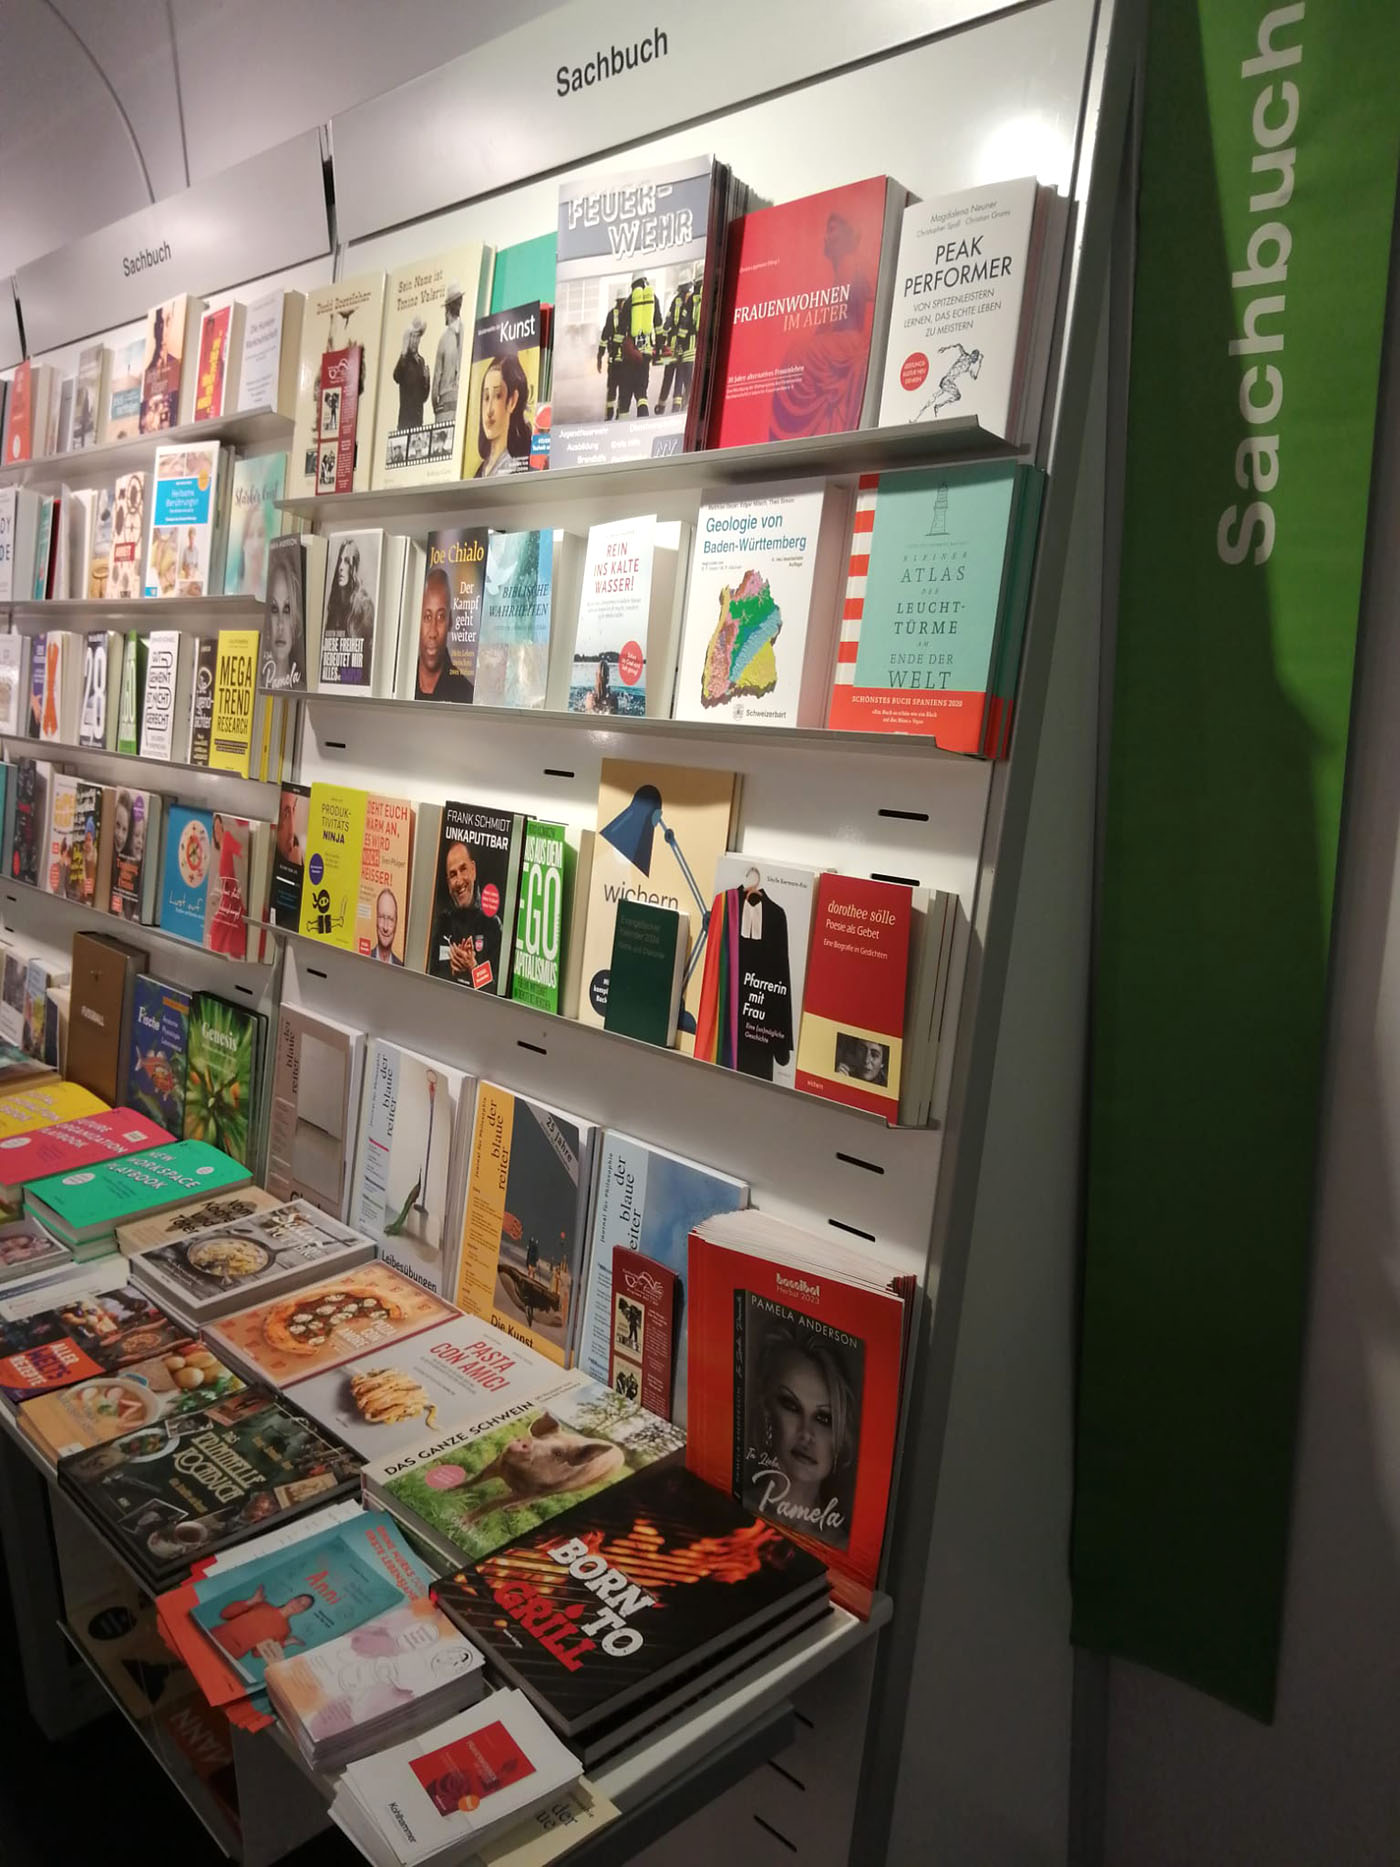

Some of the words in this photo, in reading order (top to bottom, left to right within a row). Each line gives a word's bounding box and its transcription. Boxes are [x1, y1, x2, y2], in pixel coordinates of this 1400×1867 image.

[557, 27, 668, 97] Sachbuch
[568, 184, 672, 231] FEUER-
[608, 208, 693, 260] WEHR
[123, 241, 171, 277] Sachbuch
[935, 235, 984, 265] PEAK
[904, 256, 1012, 297] PERFORMER
[1217, 2, 1305, 566] Sachbuch
[733, 284, 851, 325] FRAUENWOHNEN
[914, 298, 931, 312] VON
[932, 288, 995, 310] SPITZENLEISTERN
[500, 314, 536, 343] Kunst
[783, 313, 801, 332] IM
[803, 303, 848, 328] ALTER
[903, 315, 933, 329] LERNEN,
[935, 311, 951, 323] DAS
[953, 305, 976, 320] ECHTE
[978, 301, 1002, 315] LEBEN
[925, 326, 936, 337] ZU
[937, 320, 973, 336] MEISTERN
[706, 514, 757, 535] Geologie
[762, 513, 783, 529] von
[430, 547, 445, 568] Joe
[448, 540, 484, 563] Chialo
[607, 541, 628, 558] REIN
[703, 535, 807, 554] Baden-Württemberg
[593, 563, 608, 577] INS
[611, 557, 640, 575] KALTE
[901, 566, 966, 583] ATLAS
[460, 581, 474, 595] Der
[502, 583, 550, 600] BIBLISCHE
[595, 575, 635, 594] WASSER!
[453, 595, 480, 613] Kampf
[489, 603, 549, 618] WAHRHEITEN
[897, 601, 966, 614] LEUCHT-
[455, 612, 473, 630] geht
[894, 619, 958, 635] TÜRME
[451, 630, 476, 643] weiter
[219, 655, 252, 688] MEGA
[890, 653, 923, 665] ENDE
[928, 655, 954, 665] DER
[262, 660, 302, 690] Pamela
[888, 671, 952, 690] WELT
[218, 688, 250, 716] TREND
[745, 709, 787, 719] Schweizerbart
[852, 695, 891, 705] SCHÖNSTES
[892, 697, 911, 706] BUCH
[912, 698, 947, 707] SPANIENS
[217, 716, 248, 735] RESEARCH
[321, 803, 352, 819] PRODUK-
[384, 803, 408, 821] EUCH
[446, 809, 473, 825] FRANK
[475, 814, 511, 832] SCHMIDT
[322, 830, 345, 845] NINJA
[372, 835, 390, 851] WIRD
[385, 820, 400, 839] AN,
[445, 826, 509, 850] UNKAPUTTBAR
[546, 839, 563, 868] DEM
[827, 900, 868, 920] dorothee
[869, 909, 896, 926] sölle
[825, 919, 846, 932] Poesie
[846, 923, 856, 934] als
[856, 926, 880, 940] Gebet
[823, 938, 834, 947] Eine
[860, 946, 889, 960] Gedichten
[744, 972, 787, 995] Pfarrerin
[742, 1003, 766, 1021] Frau
[748, 991, 765, 1005] mit
[137, 1006, 160, 1031] Fische
[201, 1021, 237, 1052] Genesis
[744, 1031, 769, 1044] Geschichte
[381, 1054, 389, 1079] der
[383, 1068, 393, 1110] blaue
[387, 1099, 398, 1137] reiter
[489, 1098, 497, 1127] der
[491, 1114, 504, 1158] blaue
[546, 1117, 556, 1132] 25
[554, 1131, 573, 1163] Jahre
[150, 1151, 175, 1162] NEW
[499, 1149, 510, 1191] reiter
[614, 1155, 626, 1186] der
[104, 1161, 168, 1190] PLAYBOOK
[126, 1157, 201, 1189] WORKSPACE
[620, 1174, 635, 1222] blaue
[630, 1208, 642, 1251] eiter
[381, 1248, 437, 1293] Leibesübungen
[490, 1314, 505, 1332] Die
[507, 1325, 533, 1350] Kunst
[751, 1295, 795, 1321] PAMELA
[797, 1315, 859, 1349] ANDERSON
[430, 1342, 465, 1369] CON
[456, 1361, 511, 1394] AMICI
[464, 1340, 516, 1372] PASTA
[384, 1457, 417, 1477] DAS
[418, 1433, 469, 1461] GANZE
[469, 1400, 536, 1437] SCHWEIN
[751, 1468, 845, 1532] Pamela
[304, 1570, 342, 1606] Anni
[546, 1537, 657, 1618] BORN
[494, 1580, 598, 1672] GRILL
[581, 1608, 645, 1657] TO
[388, 1801, 417, 1844] Kohlhammer
